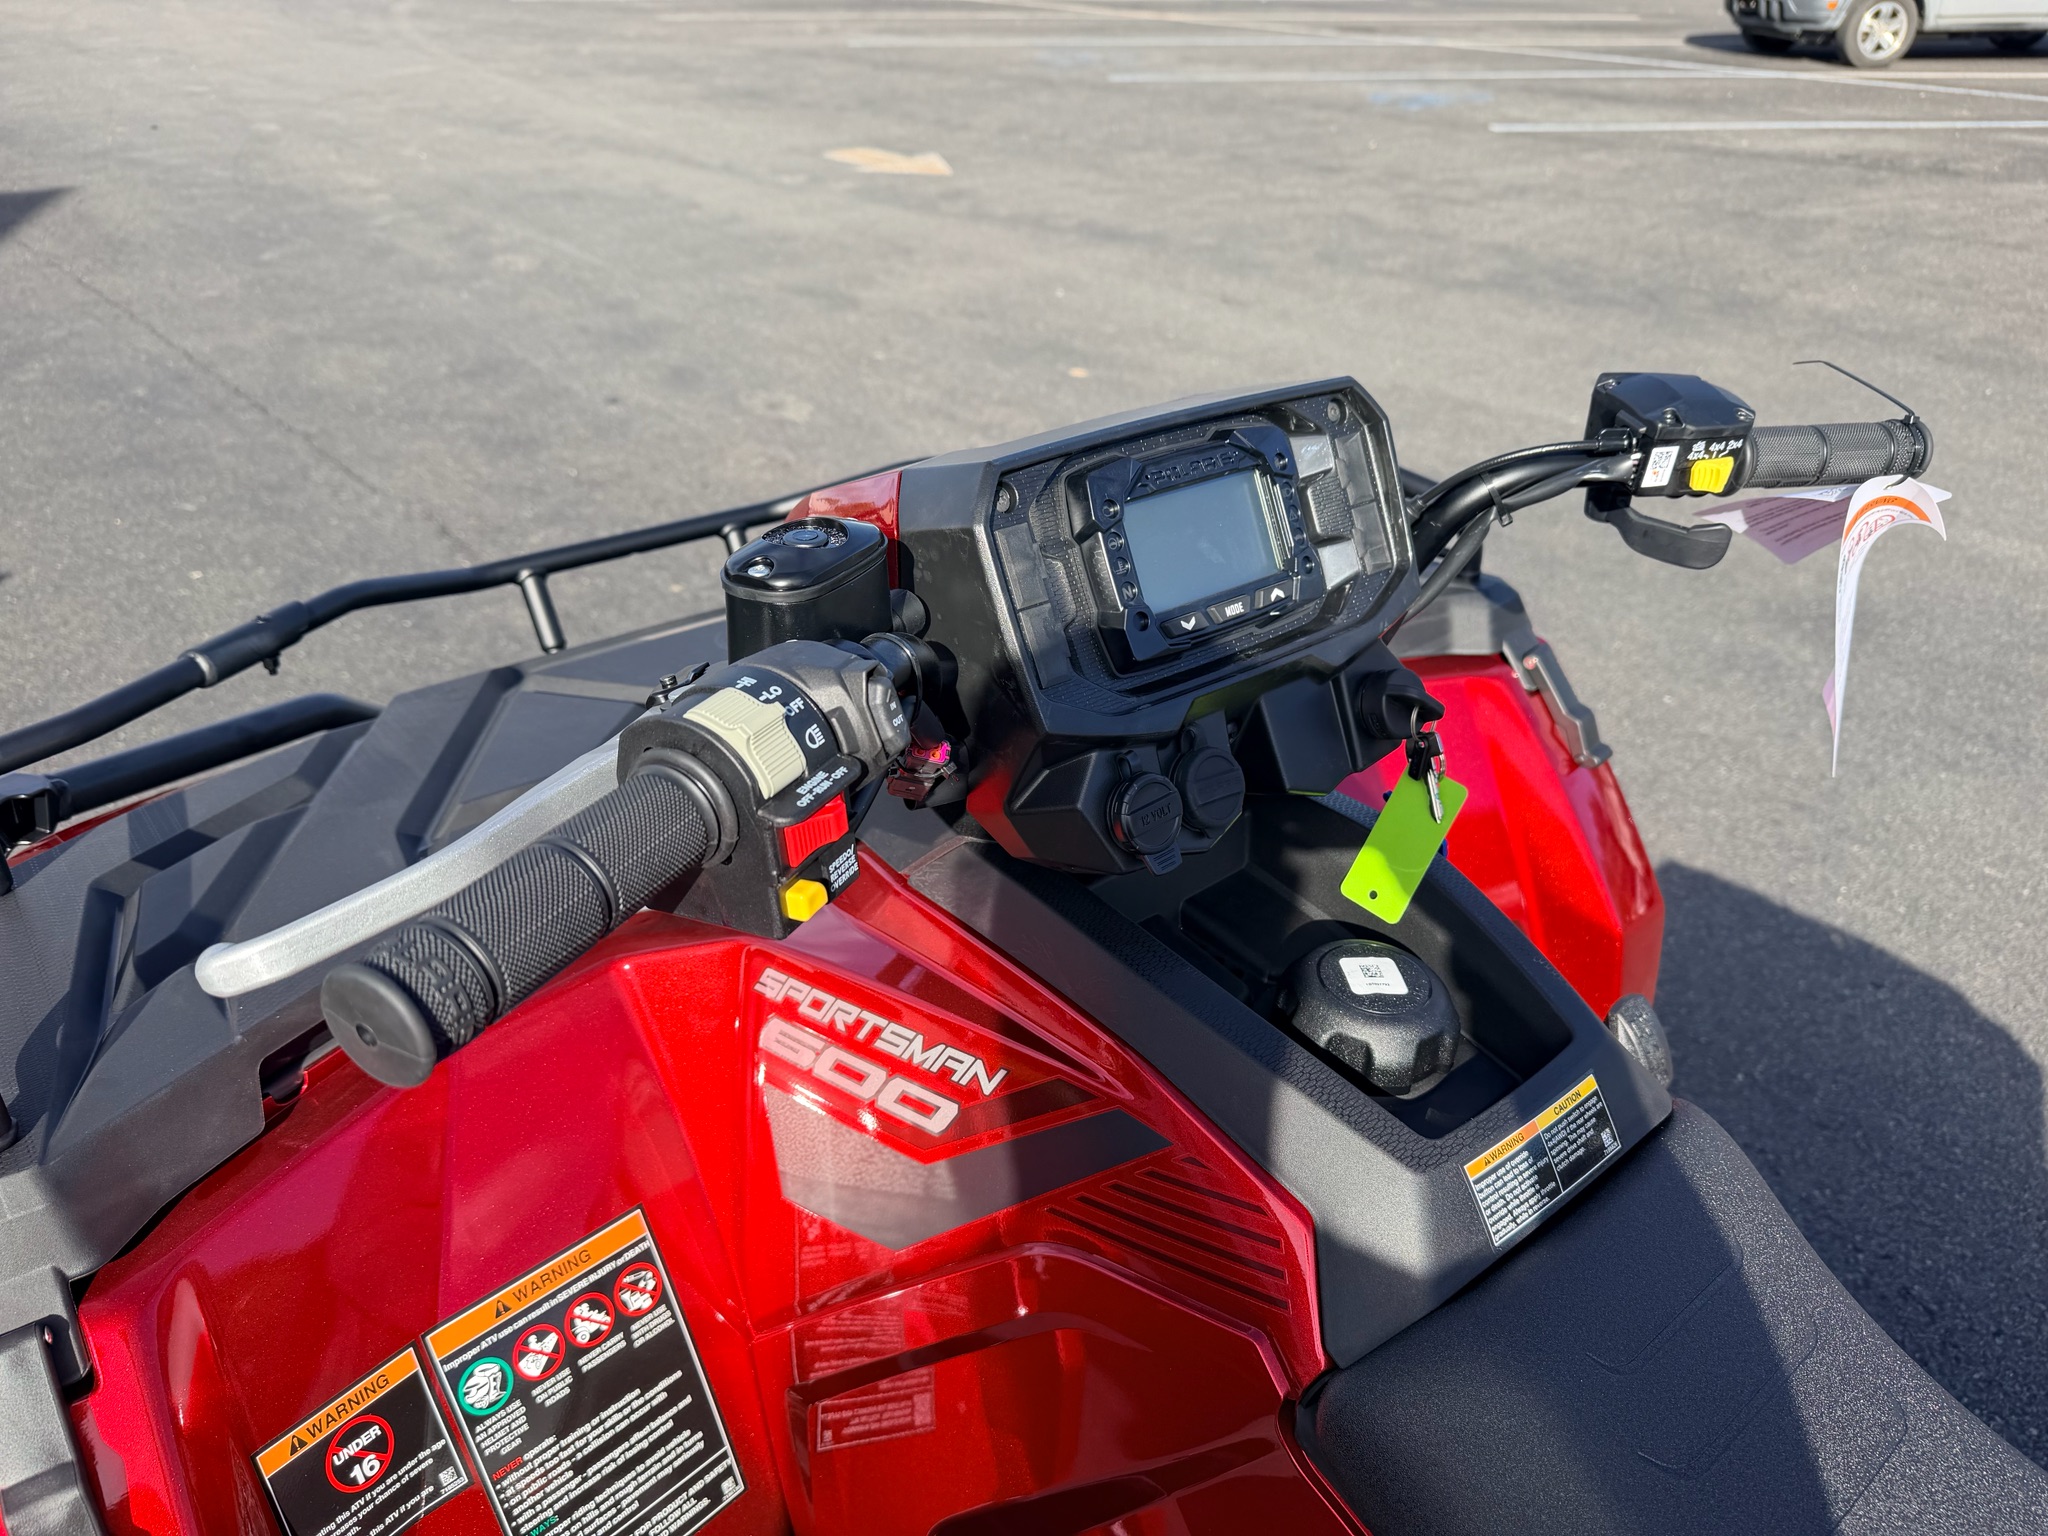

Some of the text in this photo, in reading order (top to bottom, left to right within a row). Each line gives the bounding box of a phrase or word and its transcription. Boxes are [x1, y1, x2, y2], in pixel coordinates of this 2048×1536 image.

[1224, 601, 1245, 617] MODE
[785, 697, 805, 716] OFF
[892, 714, 904, 727] OUT
[796, 770, 829, 795] ENGINE
[1152, 802, 1172, 822] VOLT
[829, 844, 854, 873] SPEEDO/
[830, 854, 856, 883] REVERSE
[830, 862, 859, 892] OVERRIDE
[753, 966, 1011, 1096] SPORTSMAN
[1553, 1089, 1581, 1116] CAUTION
[1489, 1131, 1524, 1161] WARNING
[512, 1247, 591, 1304] WARNING
[442, 1239, 650, 1374] Improper ATV use can result in SEVERE INJURY or DEATH
[629, 1303, 667, 1332] NEVER USE
[630, 1308, 671, 1341] WITH DRUGS
[576, 1330, 625, 1367] NEVER CARRY
[580, 1338, 627, 1374] PASSENGERS
[632, 1335, 645, 1349] OR
[530, 1366, 571, 1397] NEVER USE
[534, 1374, 573, 1405] ON PUBLIC
[543, 1385, 571, 1408] ROADS
[305, 1371, 390, 1440] WARNING
[474, 1398, 522, 1434] ALWAYS USE
[474, 1404, 526, 1444] AN APPROVED
[480, 1413, 527, 1449] HELMET AND
[483, 1421, 529, 1457] PROTECTIVE
[500, 1385, 641, 1488] without proper training or instruction
[504, 1367, 683, 1498] at speeds too fast for your skills or the conditions
[332, 1423, 381, 1467] UNDER
[491, 1432, 557, 1482] NEVER operate:
[499, 1436, 522, 1456] GEAR
[508, 1493, 521, 1507] on
[520, 1474, 548, 1499] public
[546, 1457, 571, 1480] roads
[581, 1426, 615, 1456] collision
[613, 1417, 630, 1433] can
[628, 1402, 652, 1423] occur
[649, 1388, 668, 1408] with
[516, 1506, 535, 1525] with
[534, 1503, 542, 1512] a
[541, 1473, 583, 1509] passenger
[585, 1439, 630, 1477] passengers
[628, 1424, 650, 1445] affect
[676, 1393, 692, 1410] and
[335, 1509, 350, 1524] this
[349, 1496, 365, 1513] ATV
[364, 1491, 372, 1501] if
[371, 1482, 386, 1497] you
[385, 1472, 398, 1485] are
[397, 1455, 418, 1476] under
[417, 1446, 431, 1460] the
[430, 1437, 446, 1453] age
[347, 1451, 382, 1489] 16
[357, 1501, 375, 1519] your
[373, 1480, 401, 1505] chance
[400, 1473, 409, 1484] of
[409, 1456, 433, 1478] severe
[518, 1417, 674, 1536] steering and increase risk of losing control
[570, 1498, 596, 1523] riding
[593, 1467, 637, 1505] techniques
[634, 1461, 646, 1474] to
[643, 1446, 666, 1468] avoid
[582, 1437, 706, 1536] surfaces pavement may seriously
[369, 1483, 434, 1536] this ATV if you are
[511, 1467, 574, 1517] another vehicle
[569, 1520, 582, 1534] on
[580, 1506, 599, 1526] hills
[598, 1495, 615, 1512] and
[613, 1478, 638, 1503] rough
[636, 1460, 662, 1484] terrain
[660, 1449, 676, 1466] and
[632, 1519, 652, 1536] FOR
[650, 1490, 689, 1525] PRODUCT
[686, 1478, 705, 1497] AND
[703, 1457, 731, 1484] SAFETY
[610, 1499, 639, 1526] control
[648, 1507, 682, 1536] FOLLOW
